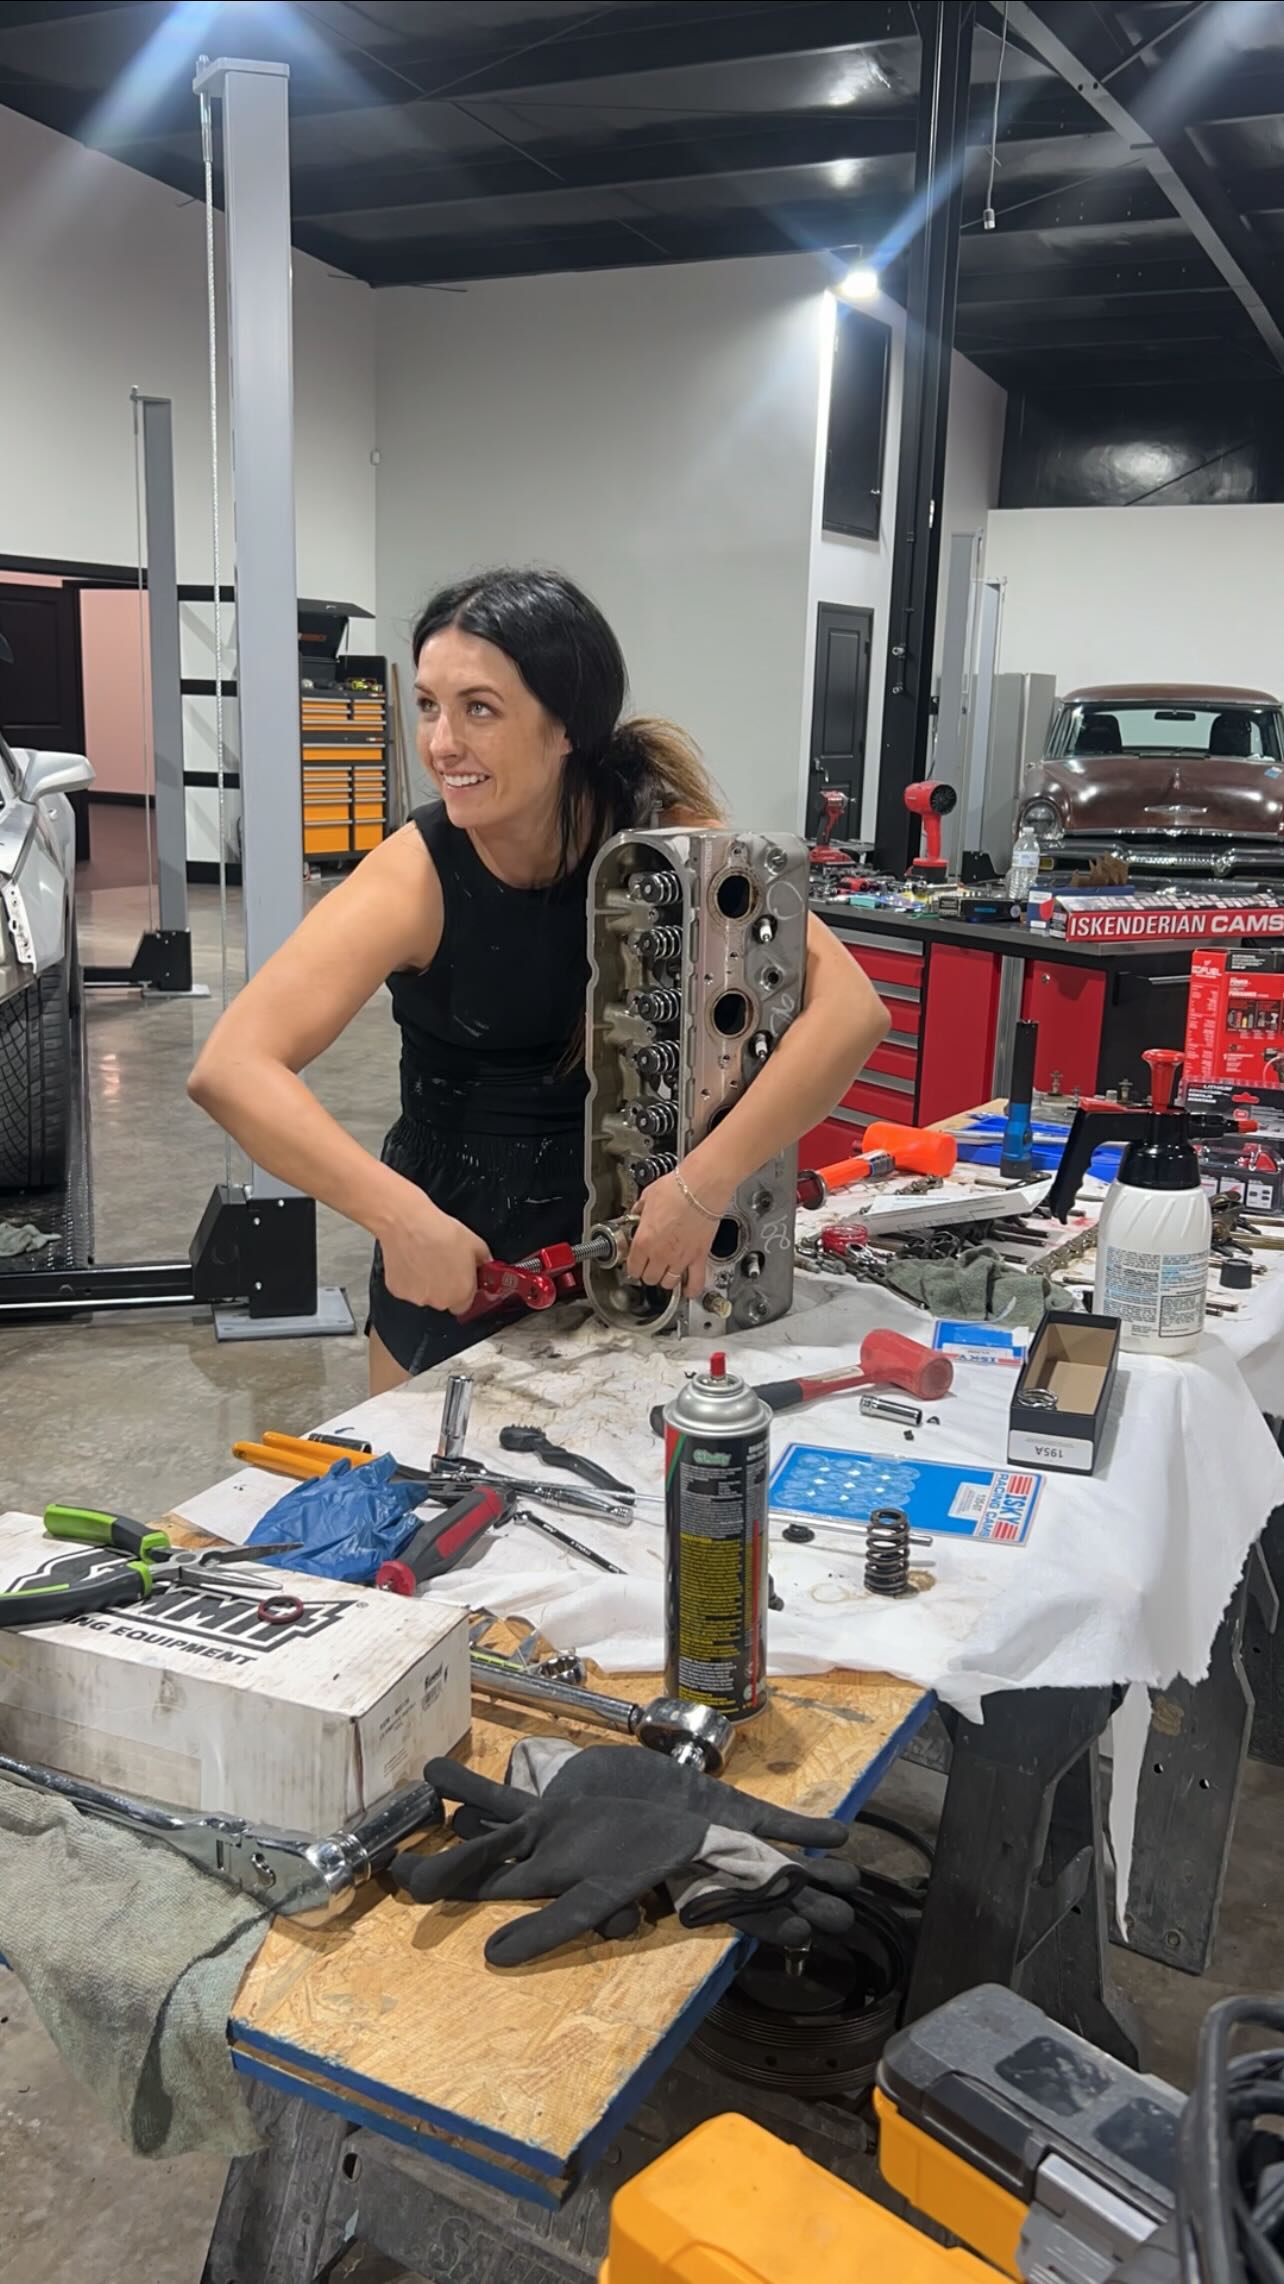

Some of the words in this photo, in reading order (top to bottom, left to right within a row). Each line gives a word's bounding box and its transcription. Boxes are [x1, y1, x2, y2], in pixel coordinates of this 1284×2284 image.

[1070, 915, 1206, 937] ISKENDERIAN
[1210, 913, 1284, 933] CAMS
[1034, 1445, 1064, 1459] 195A
[989, 1473, 1010, 1510] RACING
[980, 1510, 998, 1537] CAMS
[998, 1493, 1027, 1525] ISKY
[109, 1625, 257, 1666] EQUIPMENT
